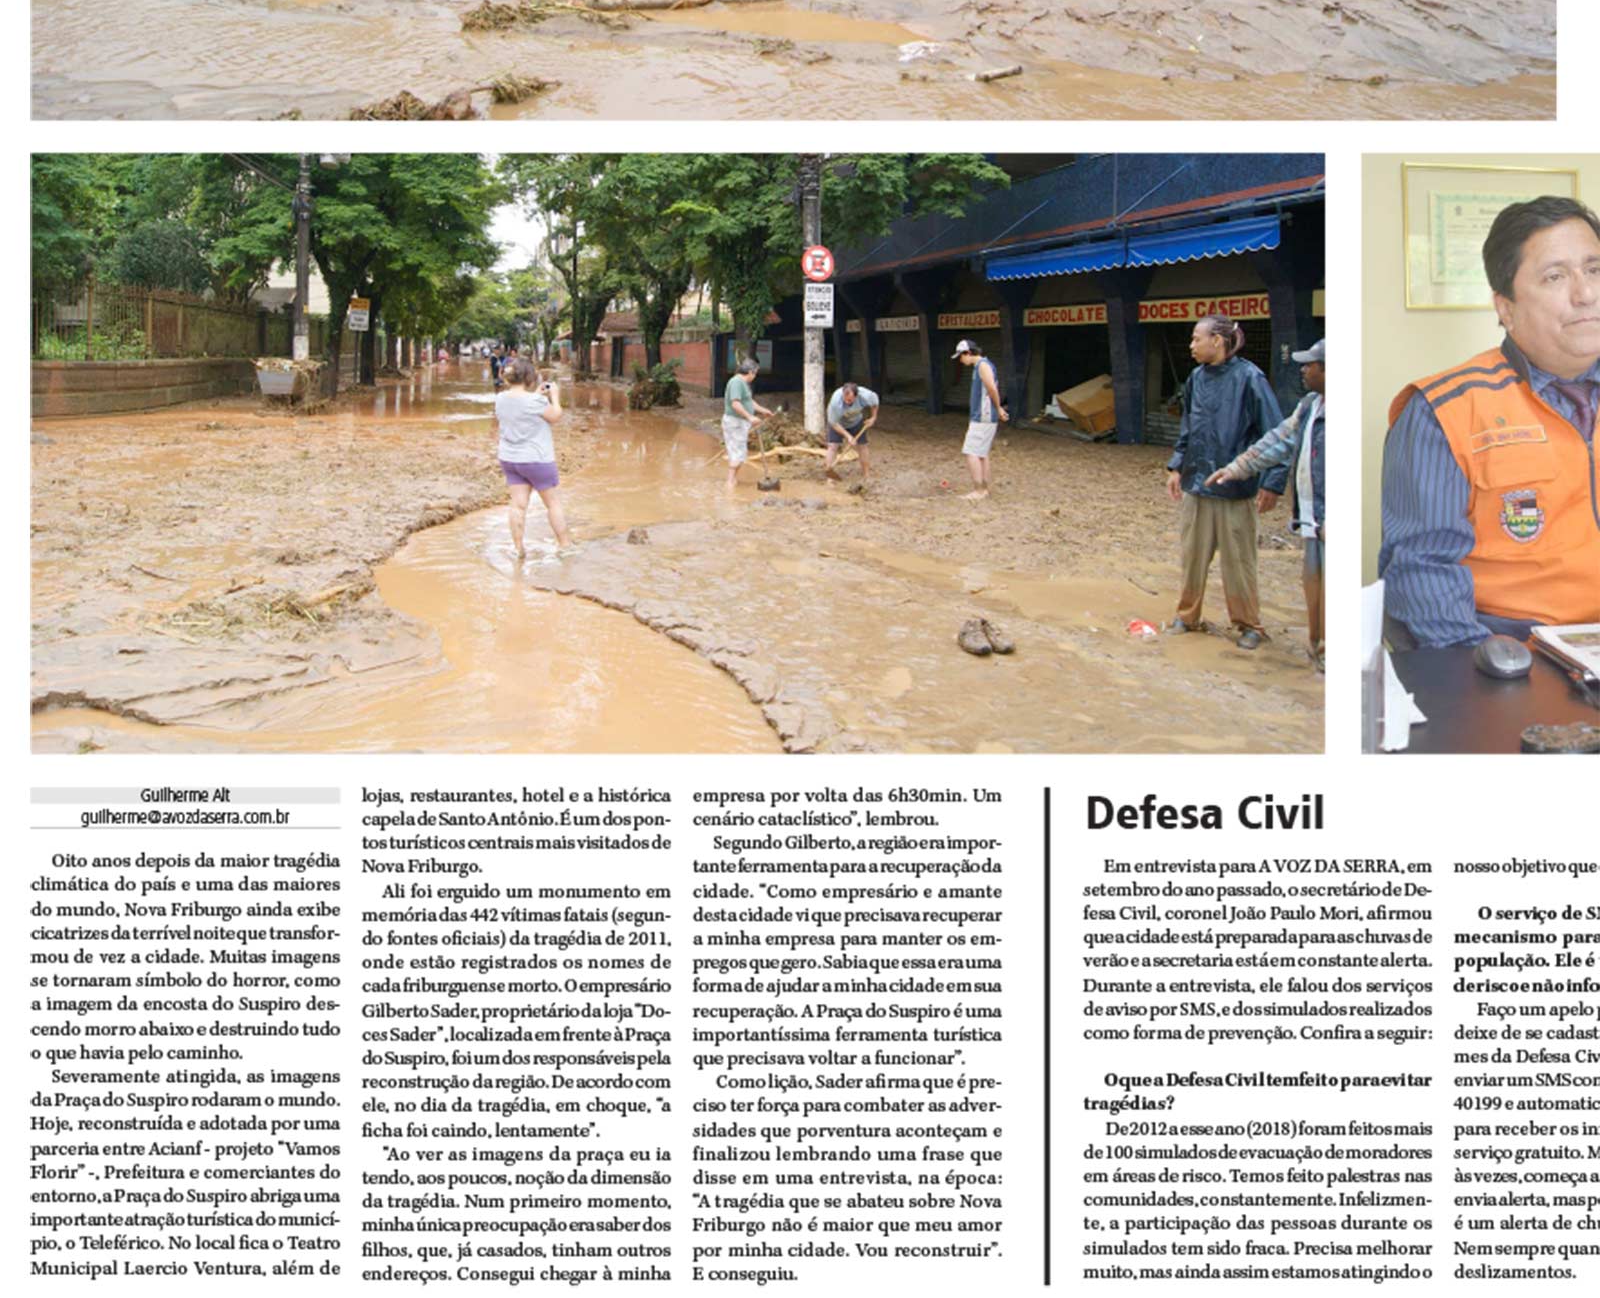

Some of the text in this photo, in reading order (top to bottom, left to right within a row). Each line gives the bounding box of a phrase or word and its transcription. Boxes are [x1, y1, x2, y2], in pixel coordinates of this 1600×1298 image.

[1027, 306, 1105, 324] CHOCOLATE
[1138, 302, 1190, 320] DOCES
[141, 787, 230, 802] Guilherme Alt
[362, 787, 671, 807] lojas, restaurantes, hotel e a histórica
[693, 787, 1001, 807] empresa por volta das 6h30min. Um
[81, 809, 289, 827] guilherme@avozdaserra.com.br
[1088, 794, 1323, 829] Defesa Civil
[52, 852, 340, 873] Oito anos depois da maior tragédia
[362, 858, 482, 878] Nova Friburgo.
[30, 876, 340, 896] climática do país e uma das maiores
[382, 883, 671, 903] Ali foi erguido um monumento em
[30, 901, 340, 921] do mundo, Nova Friburgo ainda exibe
[30, 948, 340, 969] mou de vez a cidade. Muitas imagens
[362, 953, 671, 974] onde estão registrados os nomes de
[1083, 977, 1432, 997] Durante a entrevista, ele falou dos serviços
[693, 1026, 1002, 1046] importantíssima ferramenta turística
[52, 1068, 340, 1088] Severamente atingida, as imagens
[1084, 1095, 1174, 1115] tragédias?
[416, 1151, 443, 1161] ver
[448, 1151, 467, 1161] as
[472, 1147, 543, 1166] imagens
[549, 1146, 571, 1161] da
[577, 1151, 624, 1166] praça
[630, 1151, 650, 1161] eu
[656, 1147, 671, 1161] ia
[693, 1216, 1002, 1237] Friburgo não é maior que meu amor
[1084, 1214, 1432, 1235] te, a participação das pessoas durante os
[693, 1247, 722, 1262] por
[729, 1242, 782, 1257] minha
[788, 1242, 849, 1257] cidade.
[856, 1243, 888, 1257] Vou
[30, 1260, 340, 1280] Municipal Laercio Ventura, além de
[362, 1265, 671, 1286] endereços. Consegui chegar à minha
[693, 1267, 797, 1286] E conseguiu.
[1454, 1263, 1576, 1278] deslizamentos.
